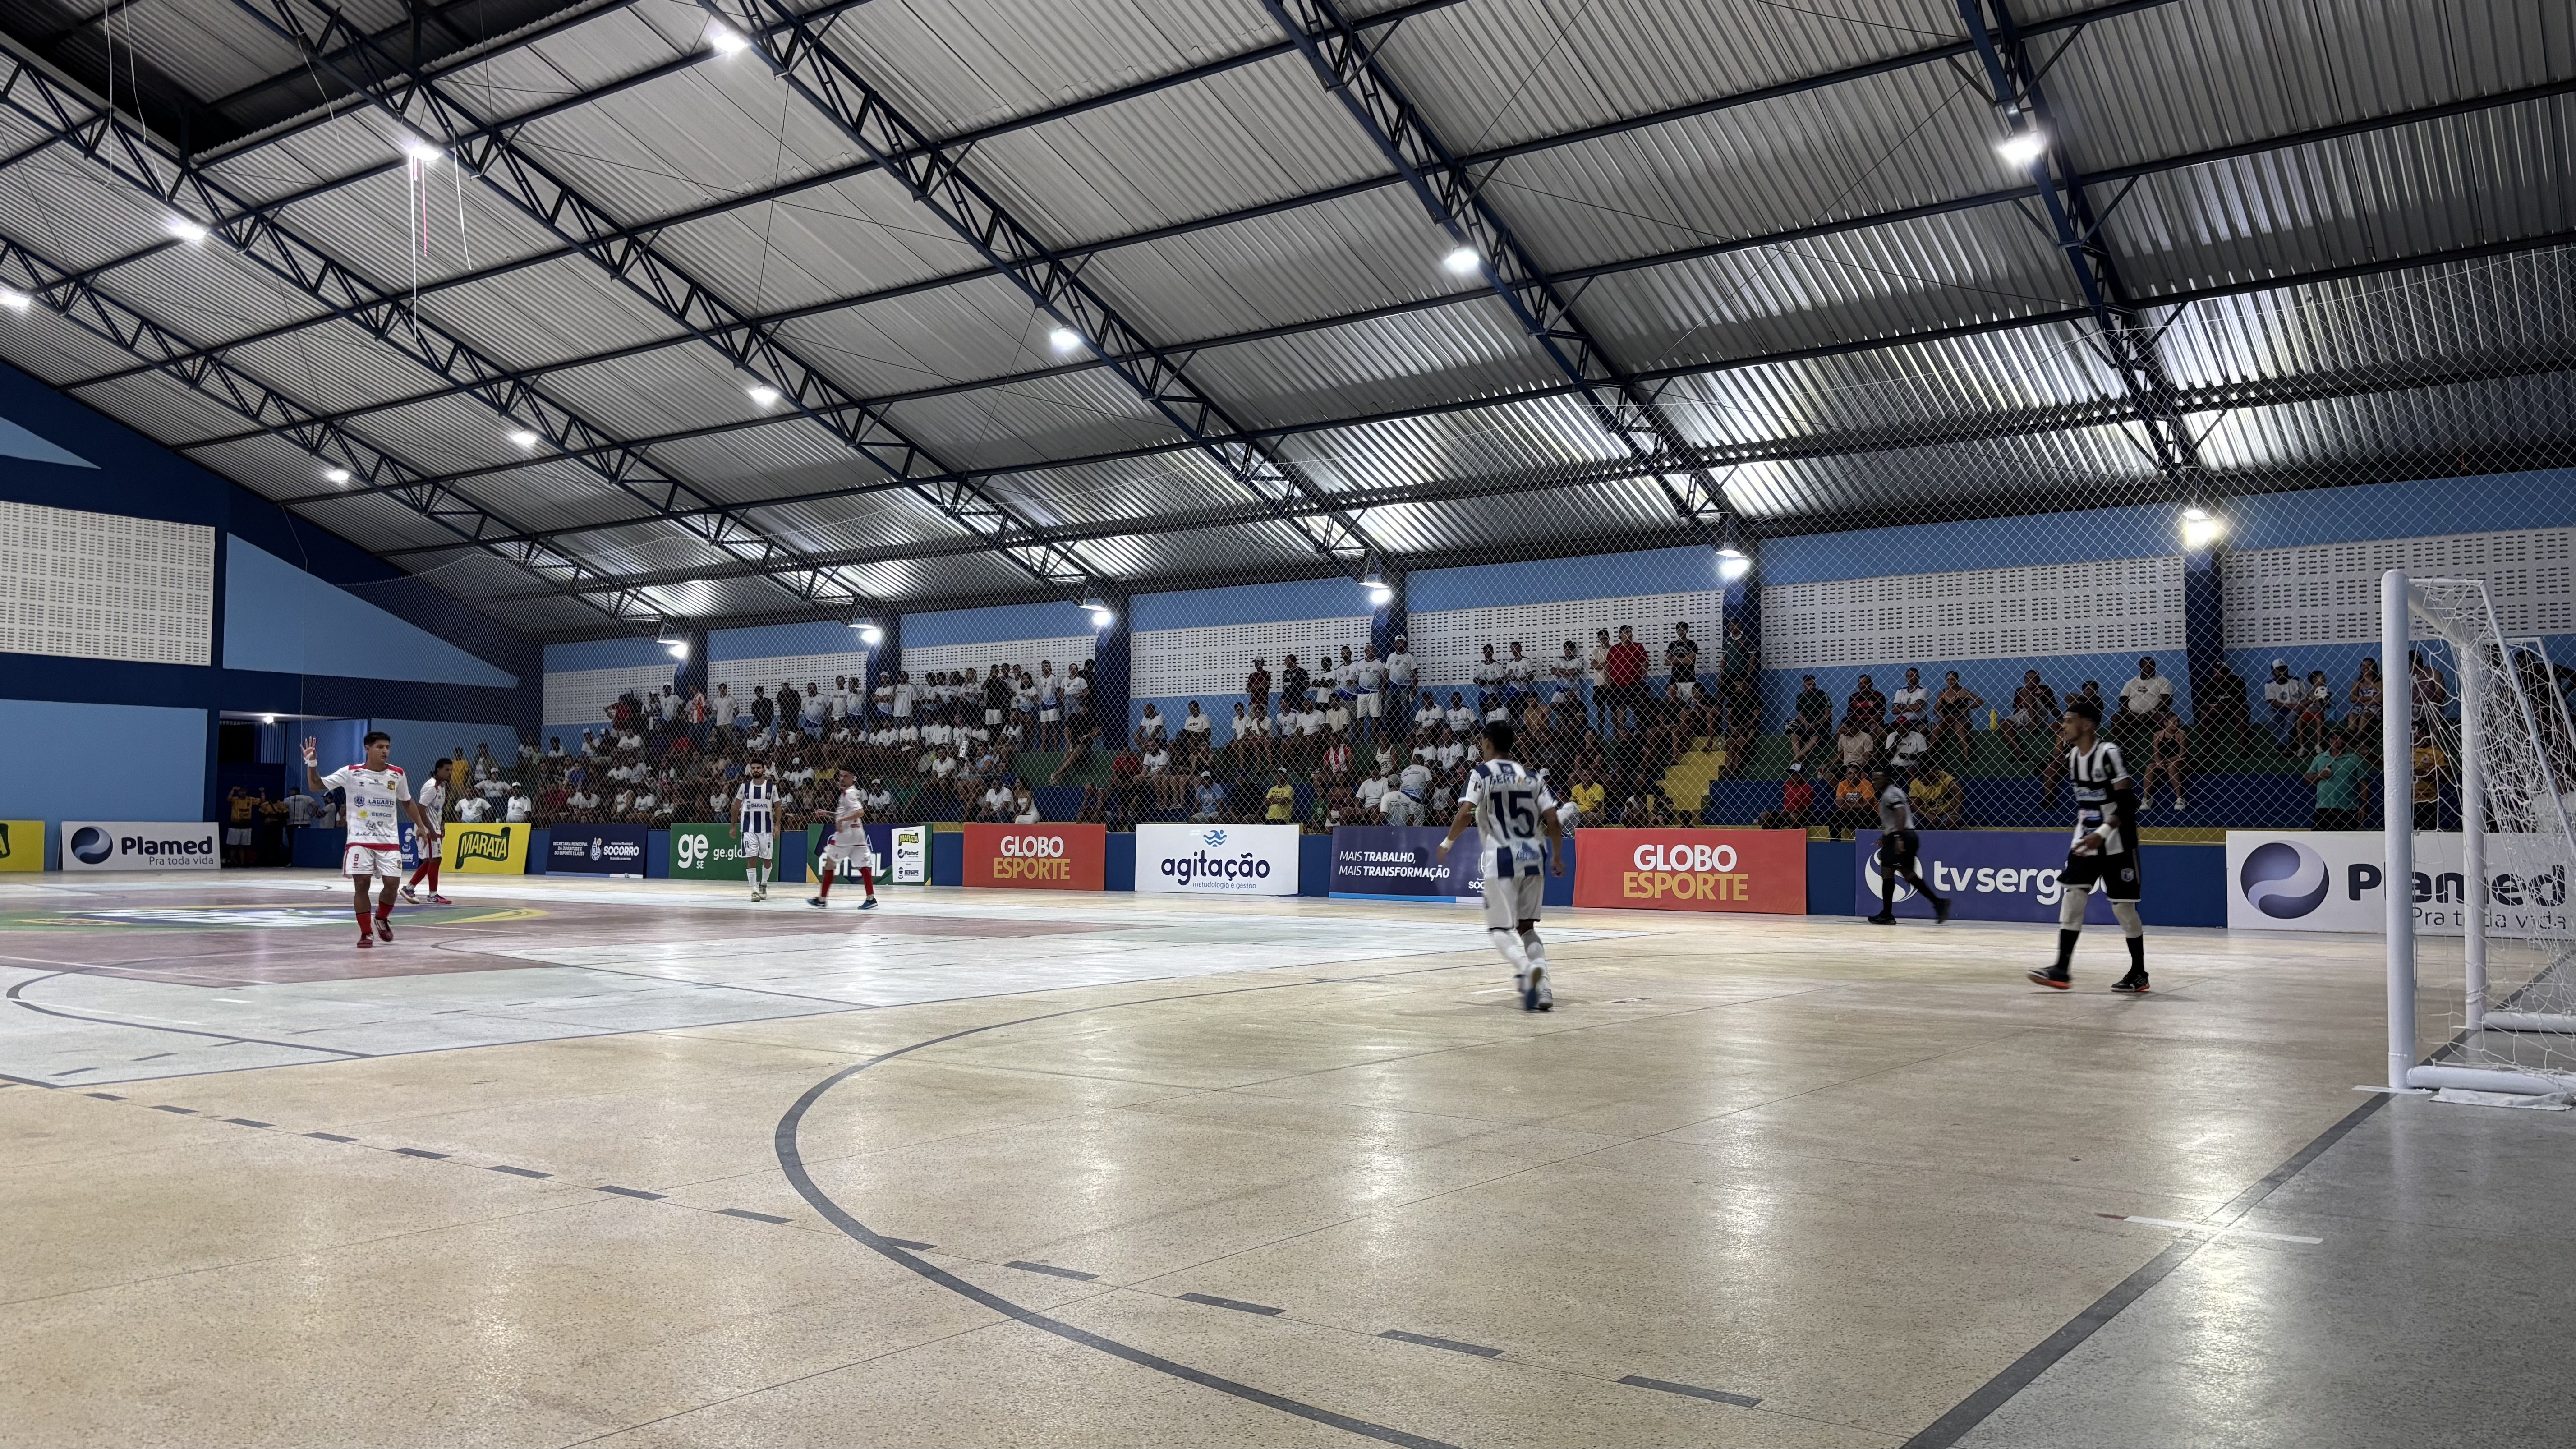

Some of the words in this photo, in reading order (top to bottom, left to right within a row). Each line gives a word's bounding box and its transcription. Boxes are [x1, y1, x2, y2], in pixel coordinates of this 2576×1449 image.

[1490, 791, 1534, 839] 15
[121, 836, 213, 855] Plamed
[603, 846, 639, 856] SOCORRO
[677, 834, 708, 869] ge
[1000, 836, 1064, 858] GLOBO
[149, 856, 164, 865] Pra
[168, 856, 190, 865] toda
[193, 856, 214, 864] vida
[696, 860, 704, 869] SE
[994, 857, 1071, 879] ESPORTE
[1161, 850, 1270, 885] agitação
[1339, 851, 1362, 861] MAIS
[1363, 851, 1416, 864] TRABALHO,
[1633, 844, 1737, 872] GLOBO
[1339, 865, 1362, 876] MAIS
[1363, 865, 1450, 881] TRANSFORMAÇÃO
[1624, 872, 1749, 901] ESPORTE
[2348, 864, 2566, 906] Pamed
[2413, 907, 2445, 925] Pra
[2453, 909, 2506, 928] tda
